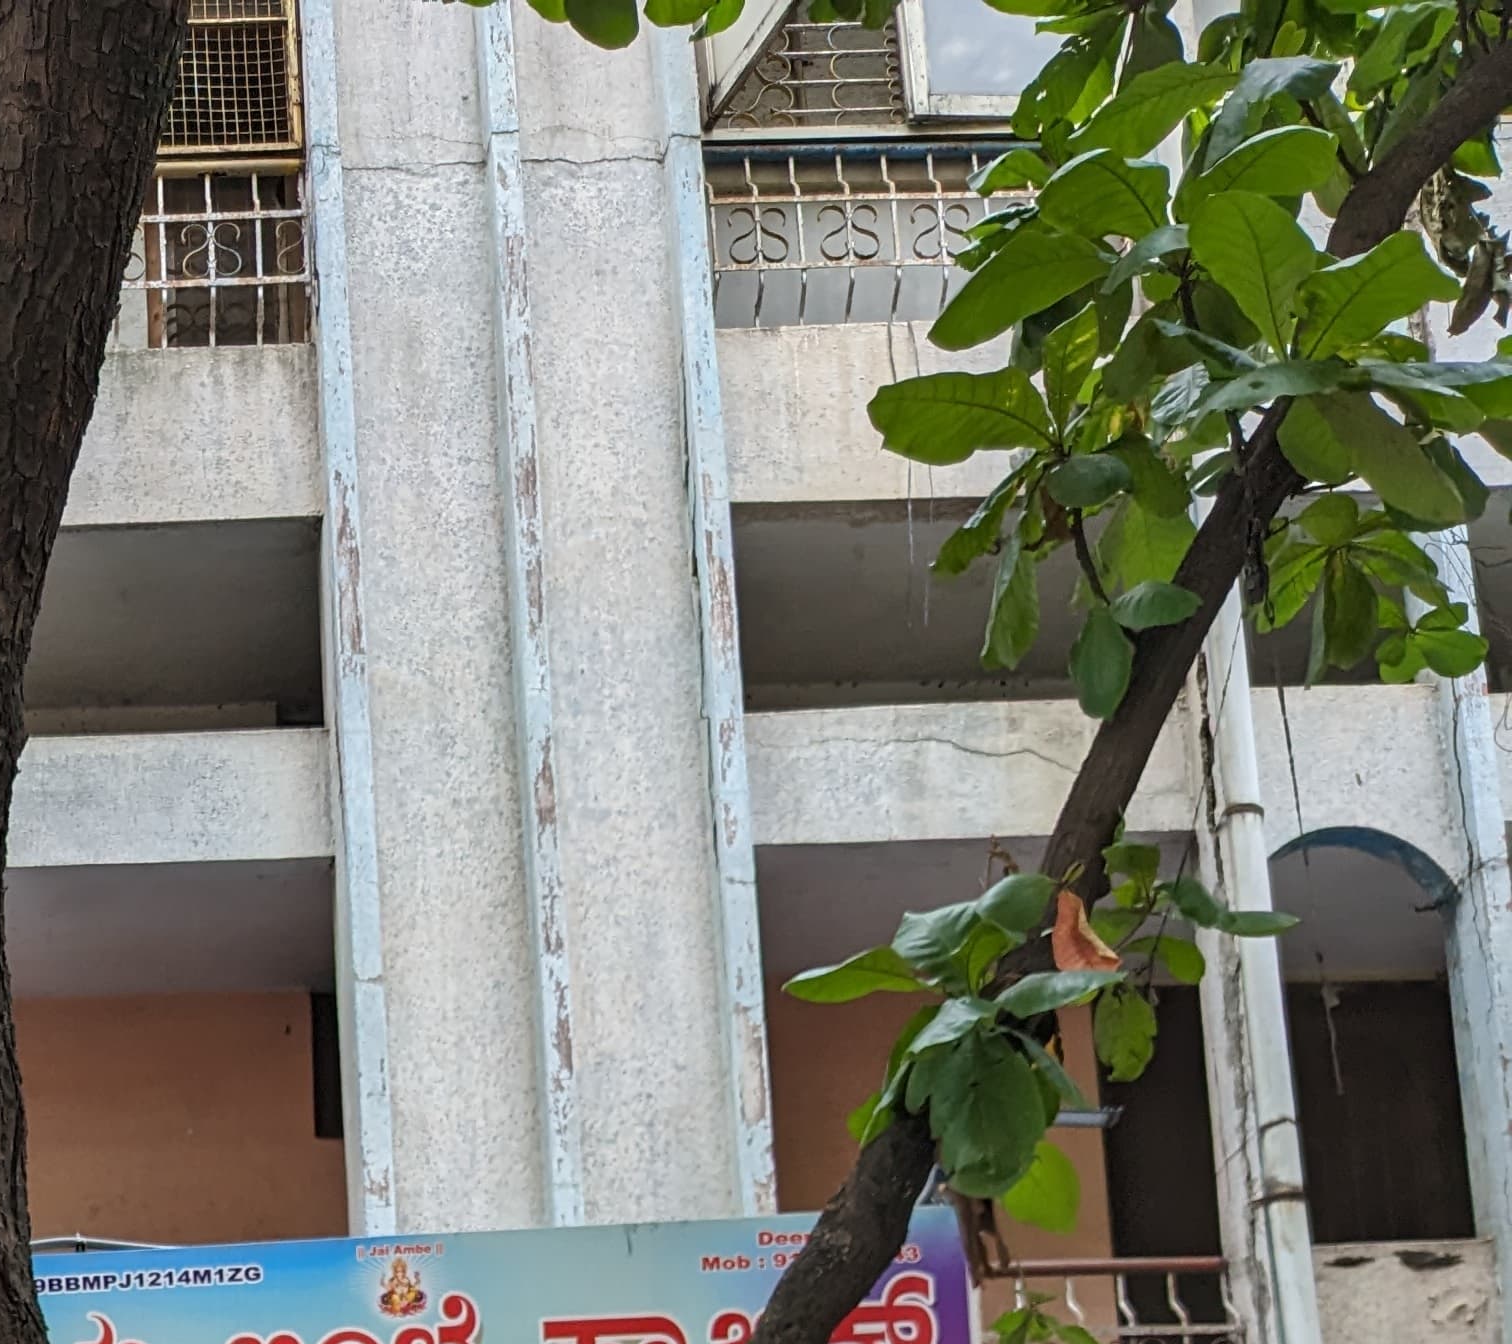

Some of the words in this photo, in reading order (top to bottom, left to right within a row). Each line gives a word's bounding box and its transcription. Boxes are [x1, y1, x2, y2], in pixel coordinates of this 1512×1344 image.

[369, 1244, 389, 1258] Jai
[394, 1244, 431, 1256] Ambe
[702, 1255, 750, 1271] Mob
[34, 1266, 262, 1294] 9BBMPJ1214M1ZG
